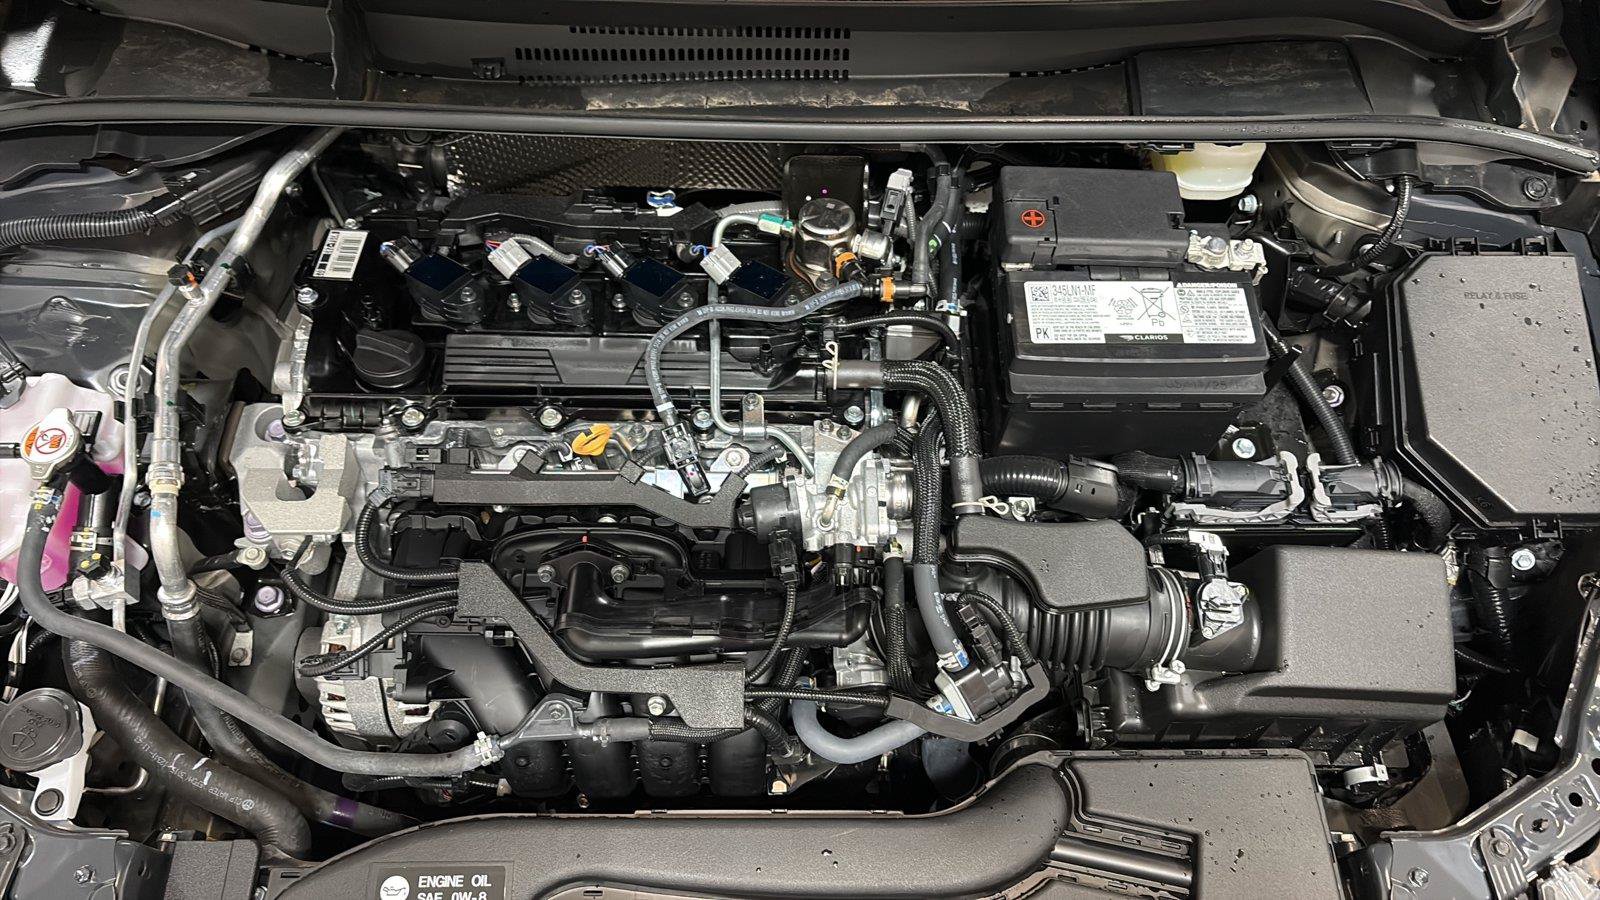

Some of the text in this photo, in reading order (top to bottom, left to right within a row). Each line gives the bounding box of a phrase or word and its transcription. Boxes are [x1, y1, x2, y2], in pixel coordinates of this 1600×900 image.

[1464, 291, 1493, 300] RELAY
[1503, 291, 1527, 300] FUSE
[1151, 319, 1165, 327] Pb
[1035, 328, 1050, 339] PK
[418, 875, 492, 887] ENGINE OIL
[417, 892, 443, 900] SAE
